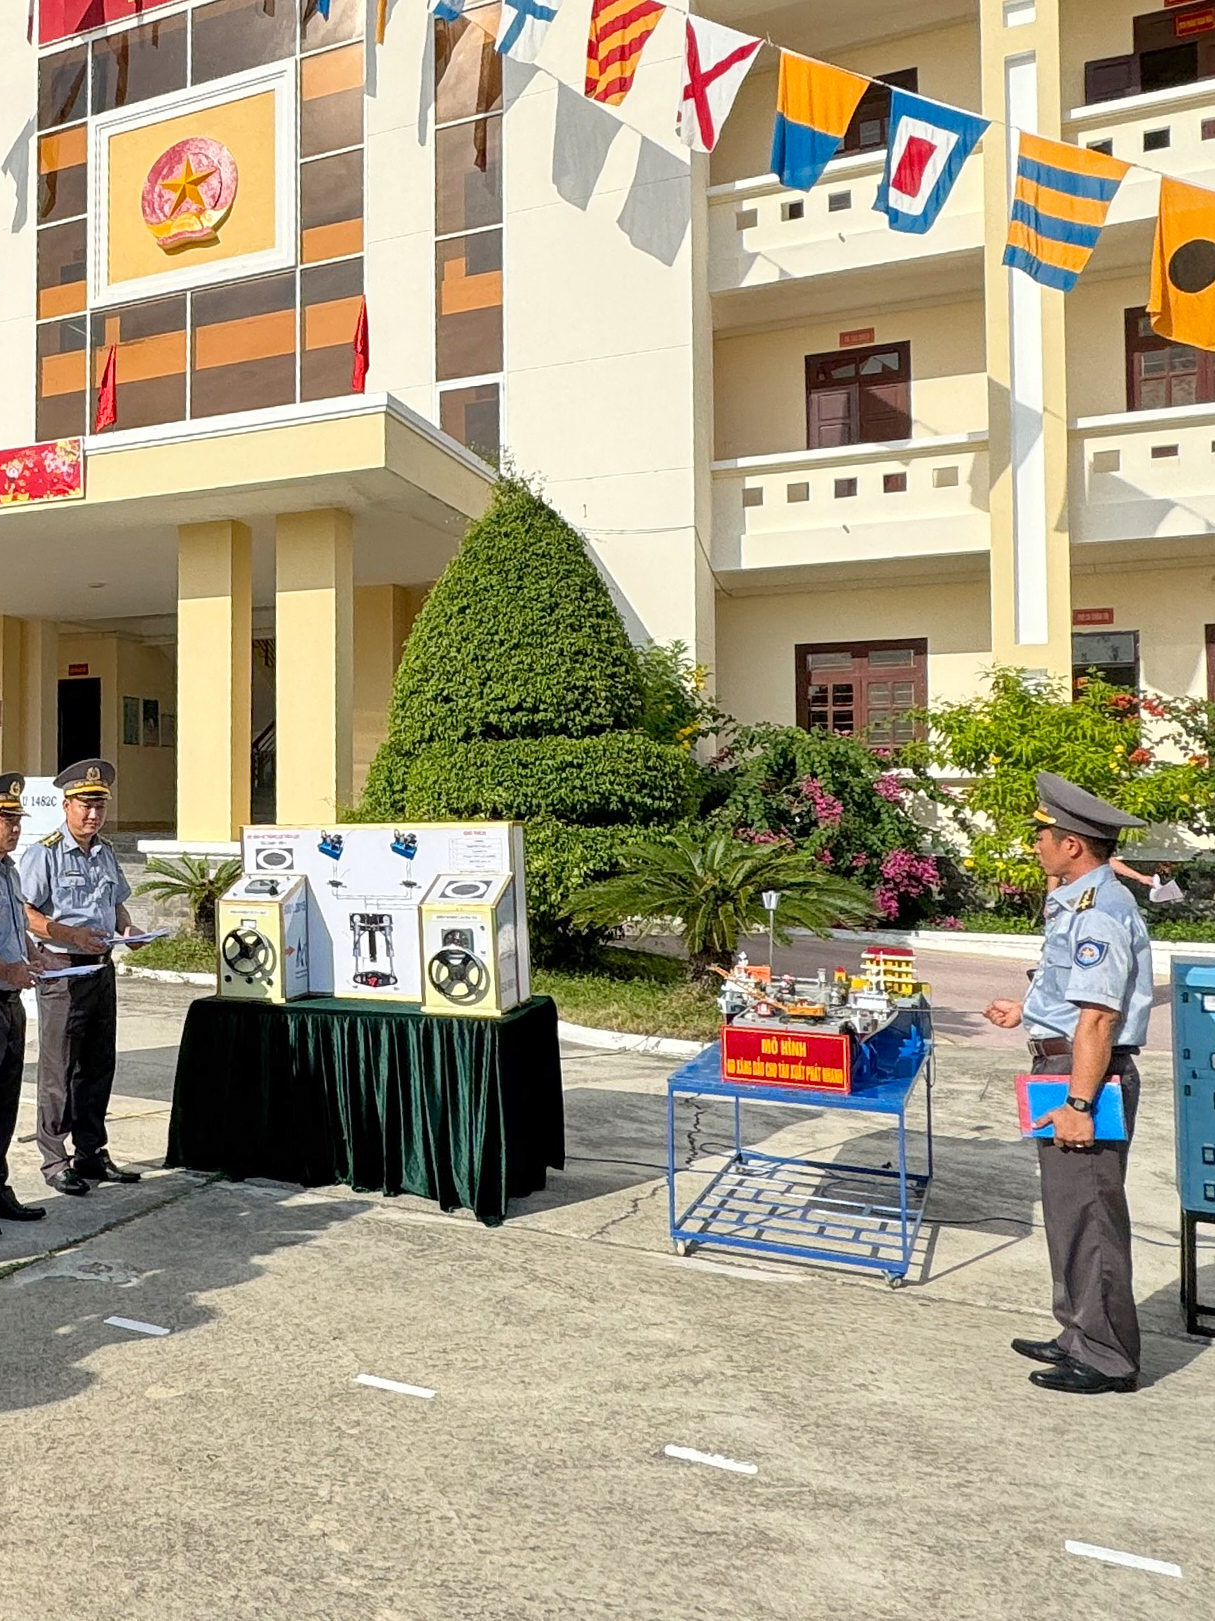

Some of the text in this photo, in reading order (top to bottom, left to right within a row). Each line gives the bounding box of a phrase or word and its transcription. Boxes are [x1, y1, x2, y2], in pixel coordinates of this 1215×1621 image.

[31, 795, 58, 807] 1482C
[761, 1036, 807, 1058] MÔ HÌNH
